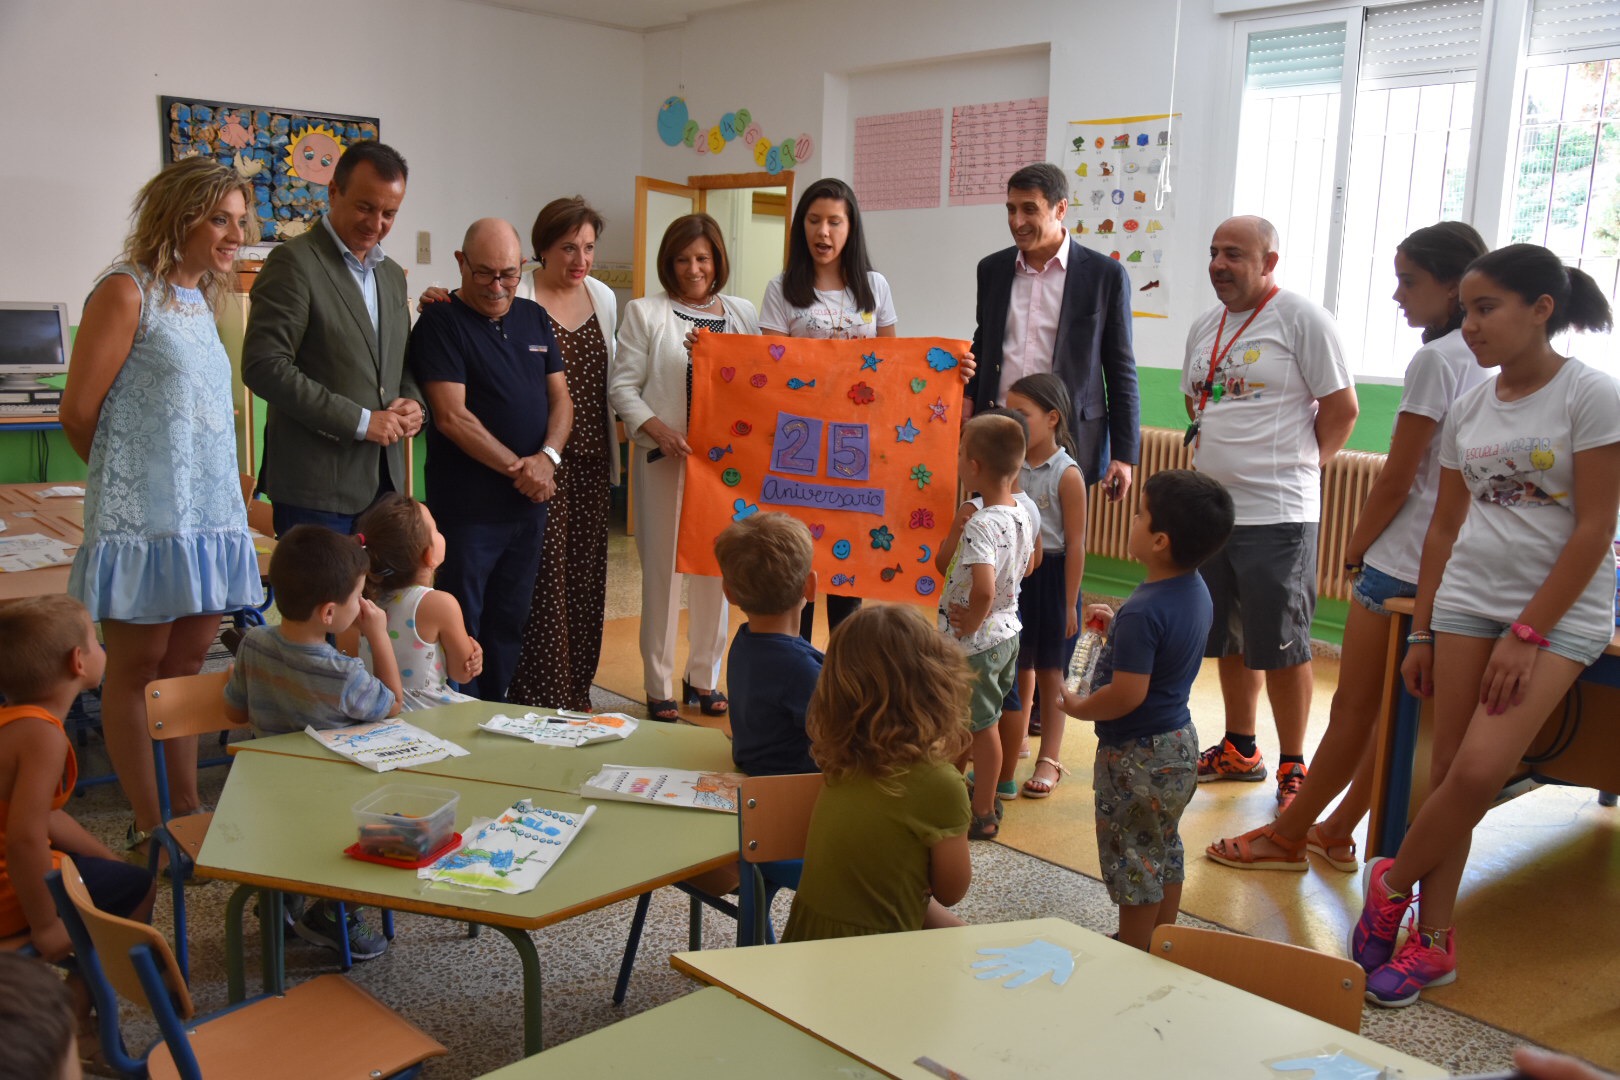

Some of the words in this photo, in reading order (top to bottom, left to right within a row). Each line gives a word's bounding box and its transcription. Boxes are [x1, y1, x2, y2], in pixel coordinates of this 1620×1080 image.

[697, 134, 705, 153] 2
[710, 131, 720, 150] 3
[723, 119, 735, 134] 4
[735, 112, 748, 133] 5
[745, 128, 758, 144] 6
[756, 142, 768, 160] 7
[768, 150, 777, 171] 8
[783, 144, 794, 161] 9
[795, 138, 810, 159] 10
[776, 419, 867, 477] 25
